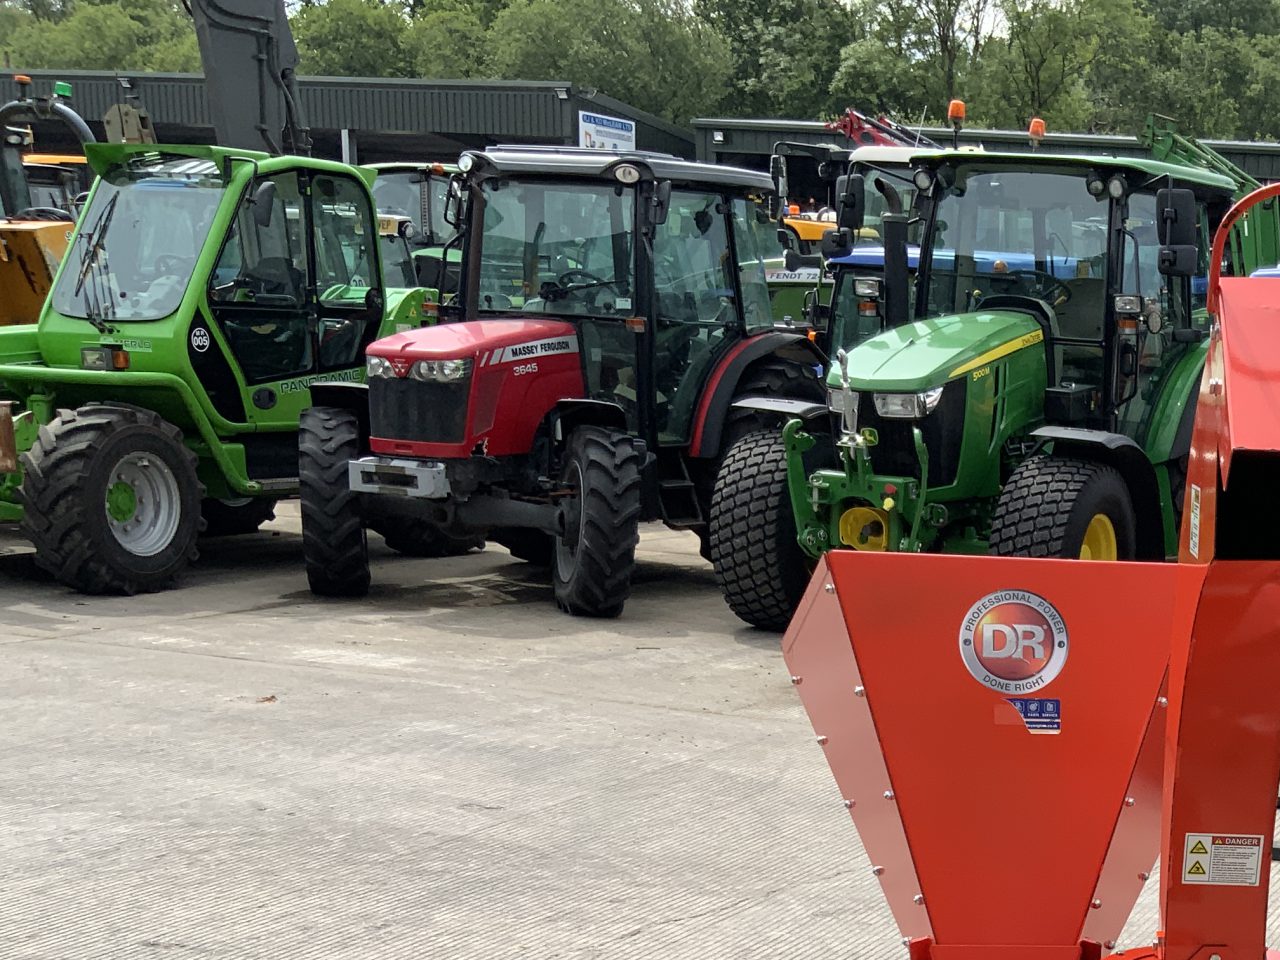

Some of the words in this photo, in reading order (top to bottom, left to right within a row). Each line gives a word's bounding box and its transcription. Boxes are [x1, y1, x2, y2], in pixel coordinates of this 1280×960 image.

[769, 272, 802, 280] FENDT
[806, 272, 820, 280] 72
[193, 336, 208, 346] 005
[511, 343, 538, 358] MASSEY
[540, 341, 570, 353] FERGUSON
[513, 363, 538, 376] 3645
[973, 366, 990, 381] 5100M
[965, 593, 1032, 632] PROFESSIONAL
[1037, 601, 1065, 635] POWER
[982, 624, 1045, 660] DR
[982, 675, 1011, 692] DONE
[1014, 676, 1046, 692] RIGHT
